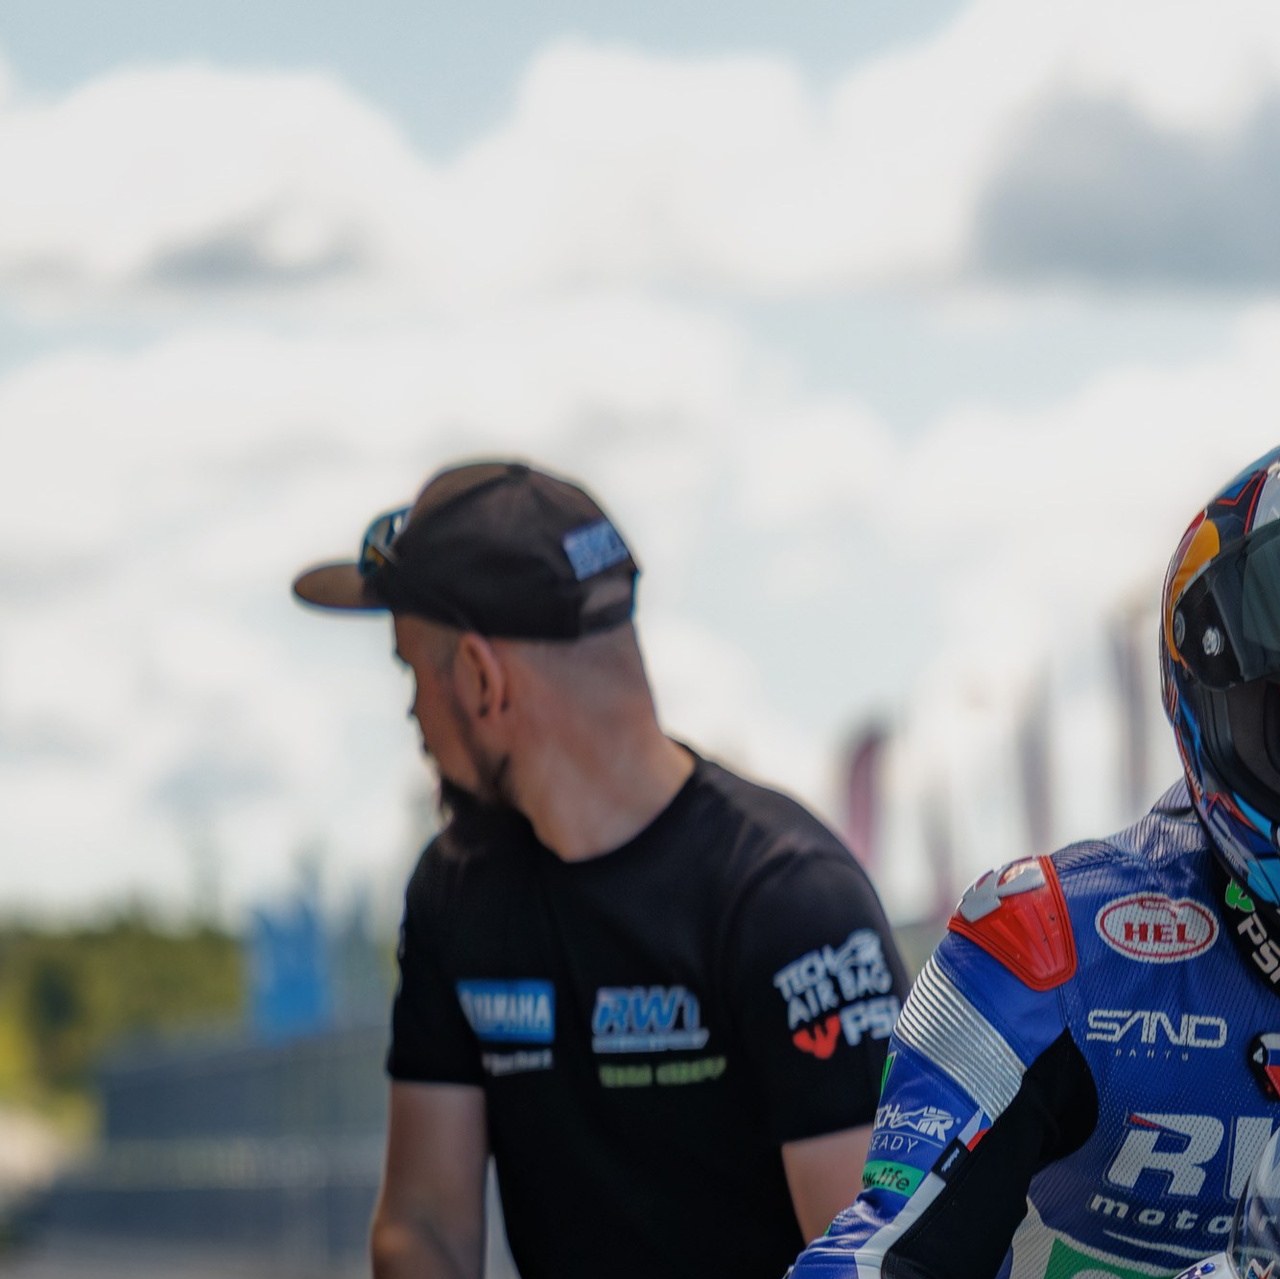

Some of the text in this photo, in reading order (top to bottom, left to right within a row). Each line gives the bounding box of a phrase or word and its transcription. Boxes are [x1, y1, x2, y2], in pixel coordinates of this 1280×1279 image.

[1123, 922, 1198, 945] HEL
[1086, 1009, 1228, 1049] SAND
[872, 1134, 918, 1154] EADY
